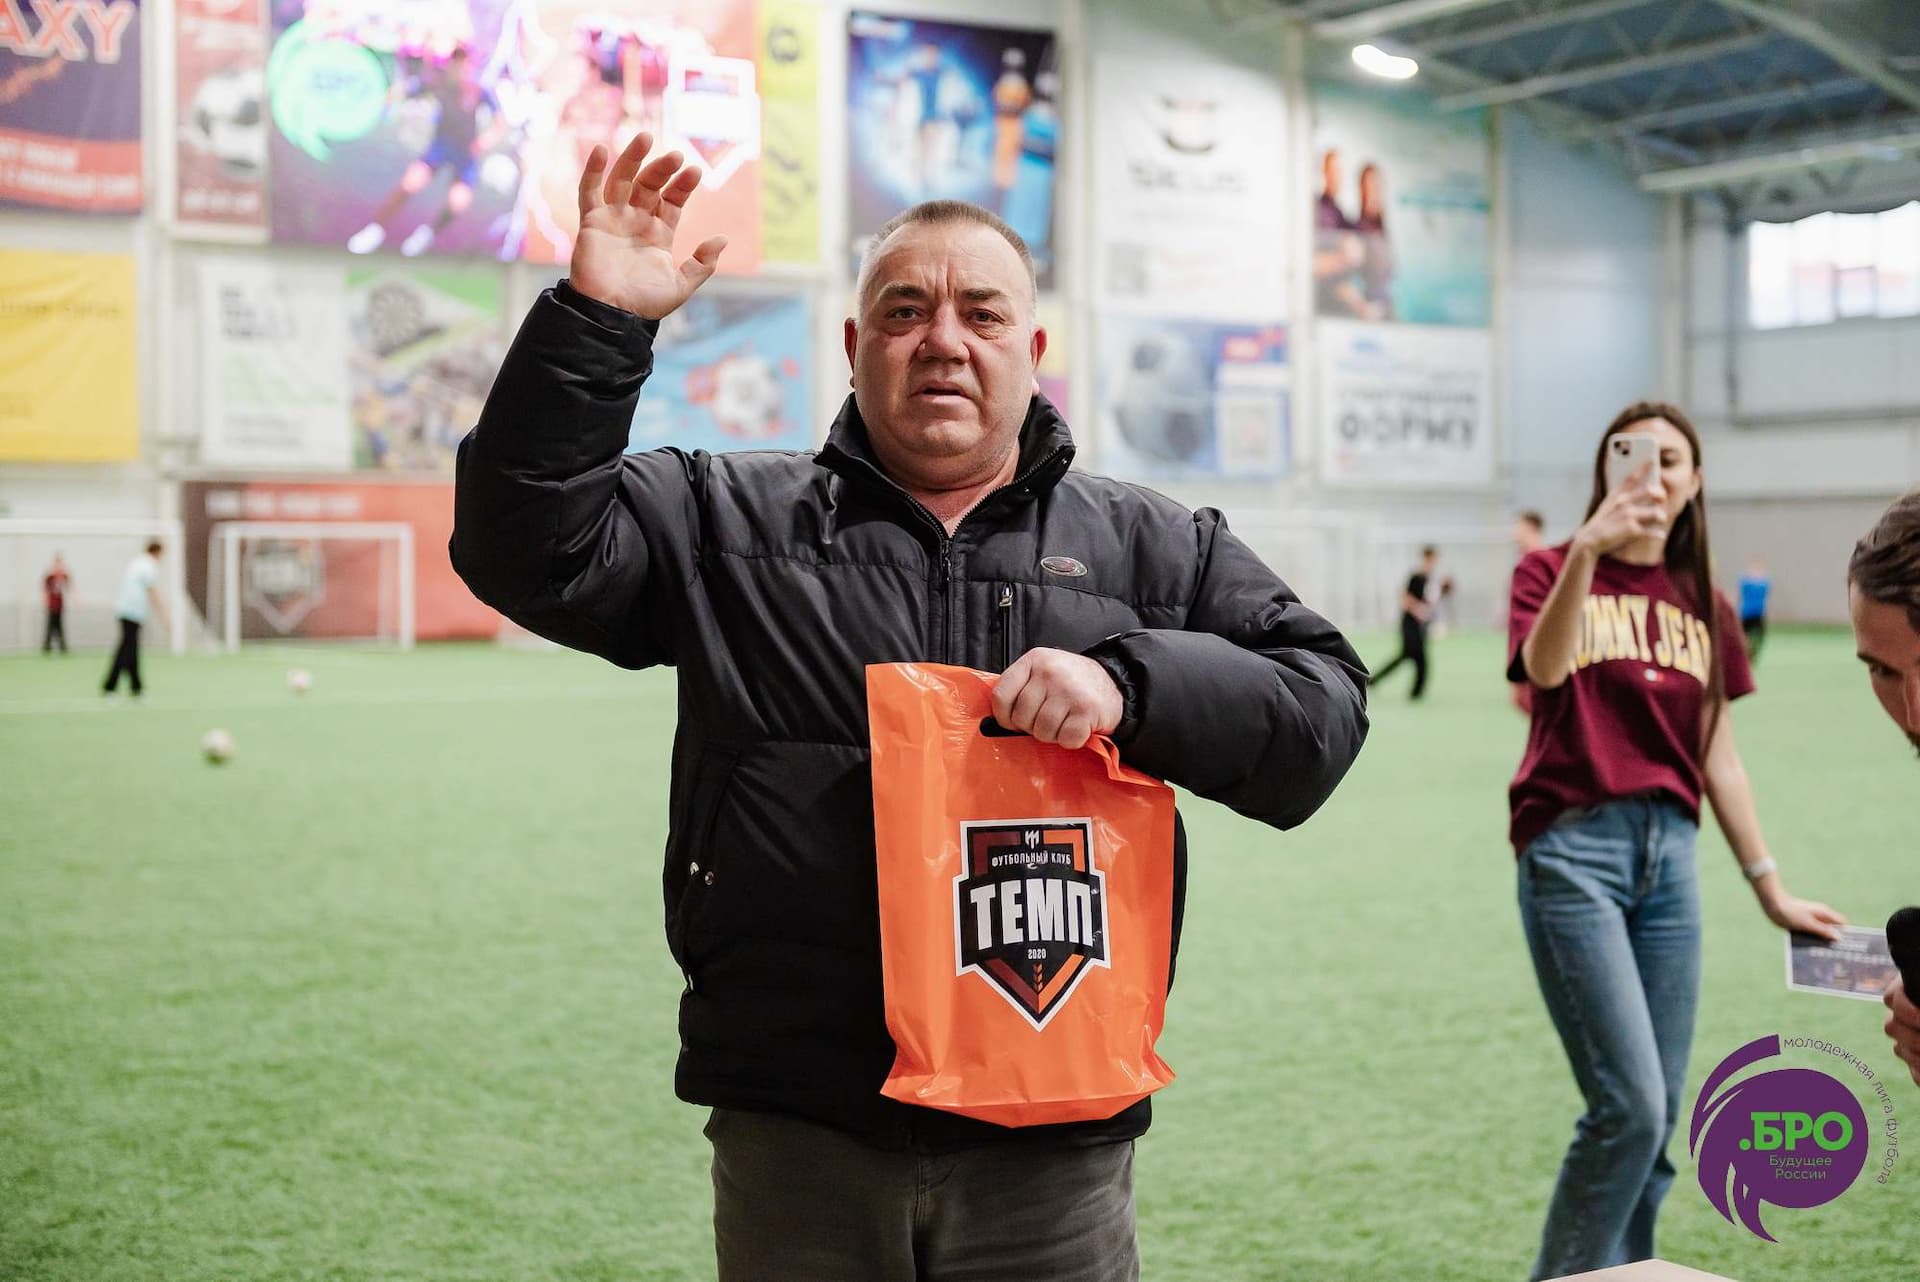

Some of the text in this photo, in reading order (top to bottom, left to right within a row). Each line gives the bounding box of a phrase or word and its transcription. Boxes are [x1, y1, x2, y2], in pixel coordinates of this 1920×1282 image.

[1568, 594, 1652, 674] OMMY
[991, 850, 1072, 867] ФУТБОЛЬНЫЙ КЛУБ
[970, 878, 1093, 951] ТЕМП
[1027, 948, 1047, 960] 2020
